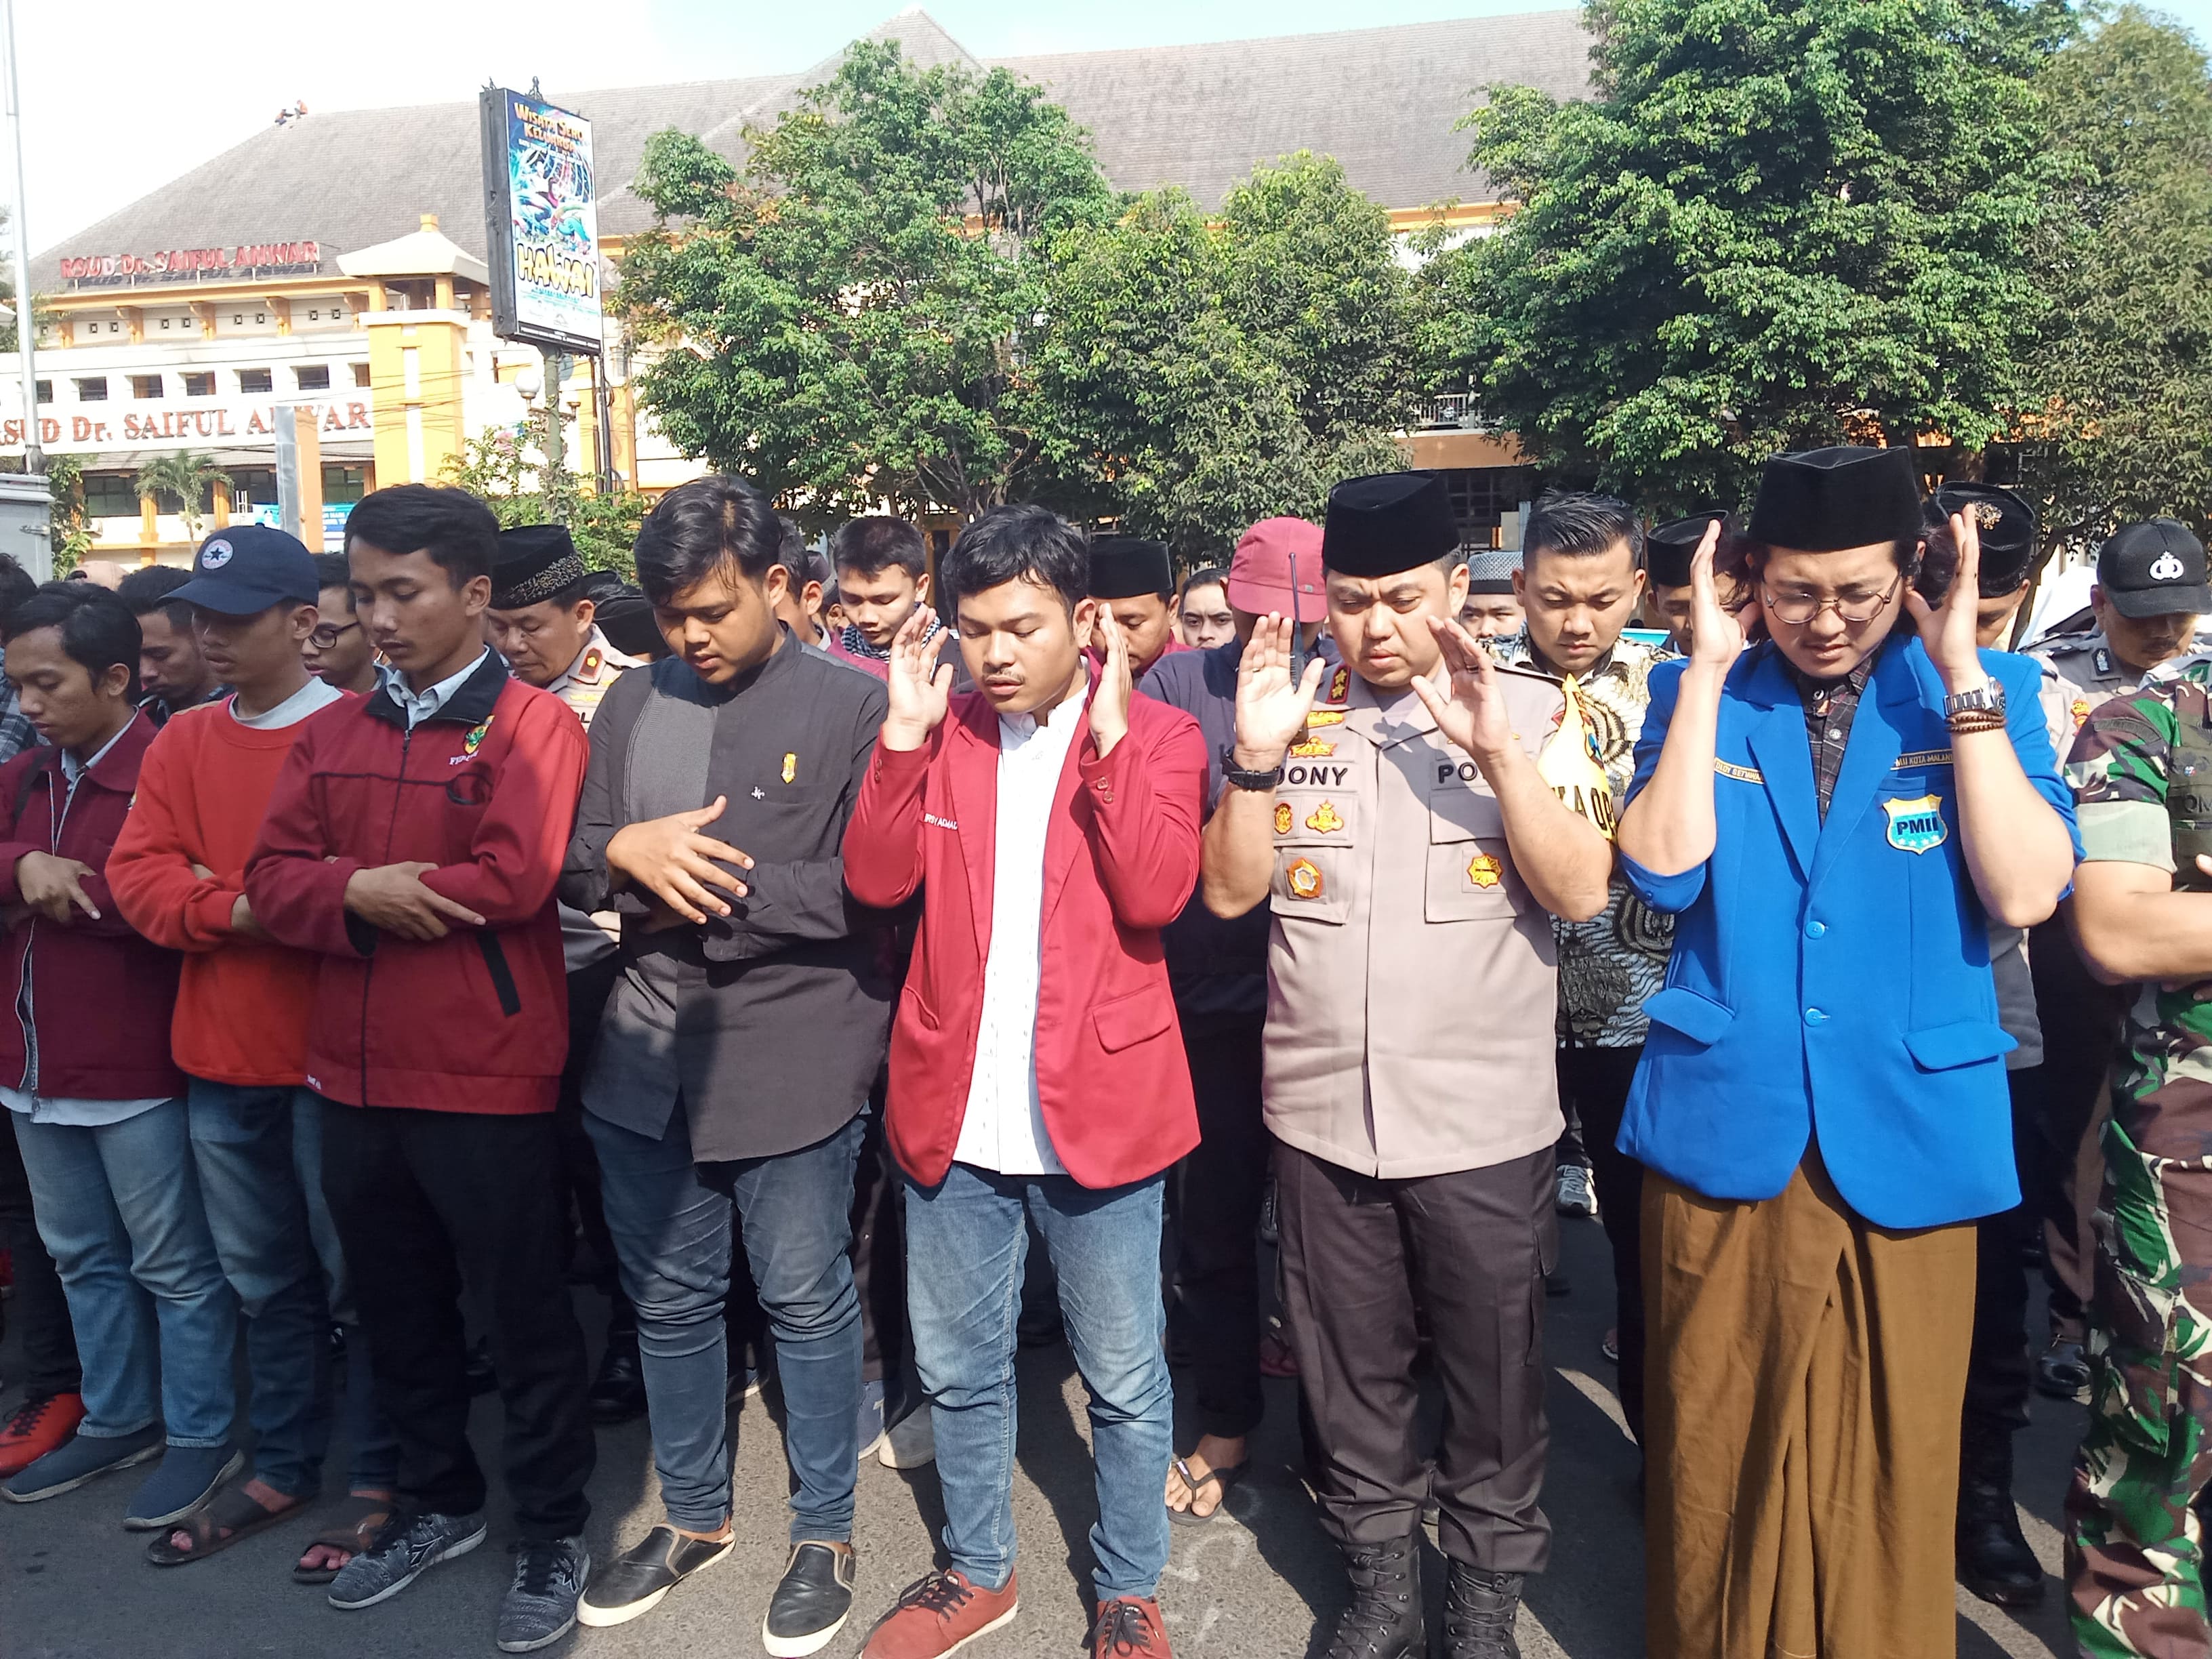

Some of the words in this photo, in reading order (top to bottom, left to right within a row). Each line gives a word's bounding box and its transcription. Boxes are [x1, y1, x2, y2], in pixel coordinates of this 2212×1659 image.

[60, 255, 115, 279] RSUD
[155, 248, 228, 272] SAIFUL
[235, 241, 317, 267] ANWAR
[517, 243, 594, 299] HAWAI
[73, 416, 111, 442] Dr.
[124, 409, 235, 439] SAIFUL
[1927, 752, 1952, 762] MALAN
[1896, 817, 1939, 836] PMII
